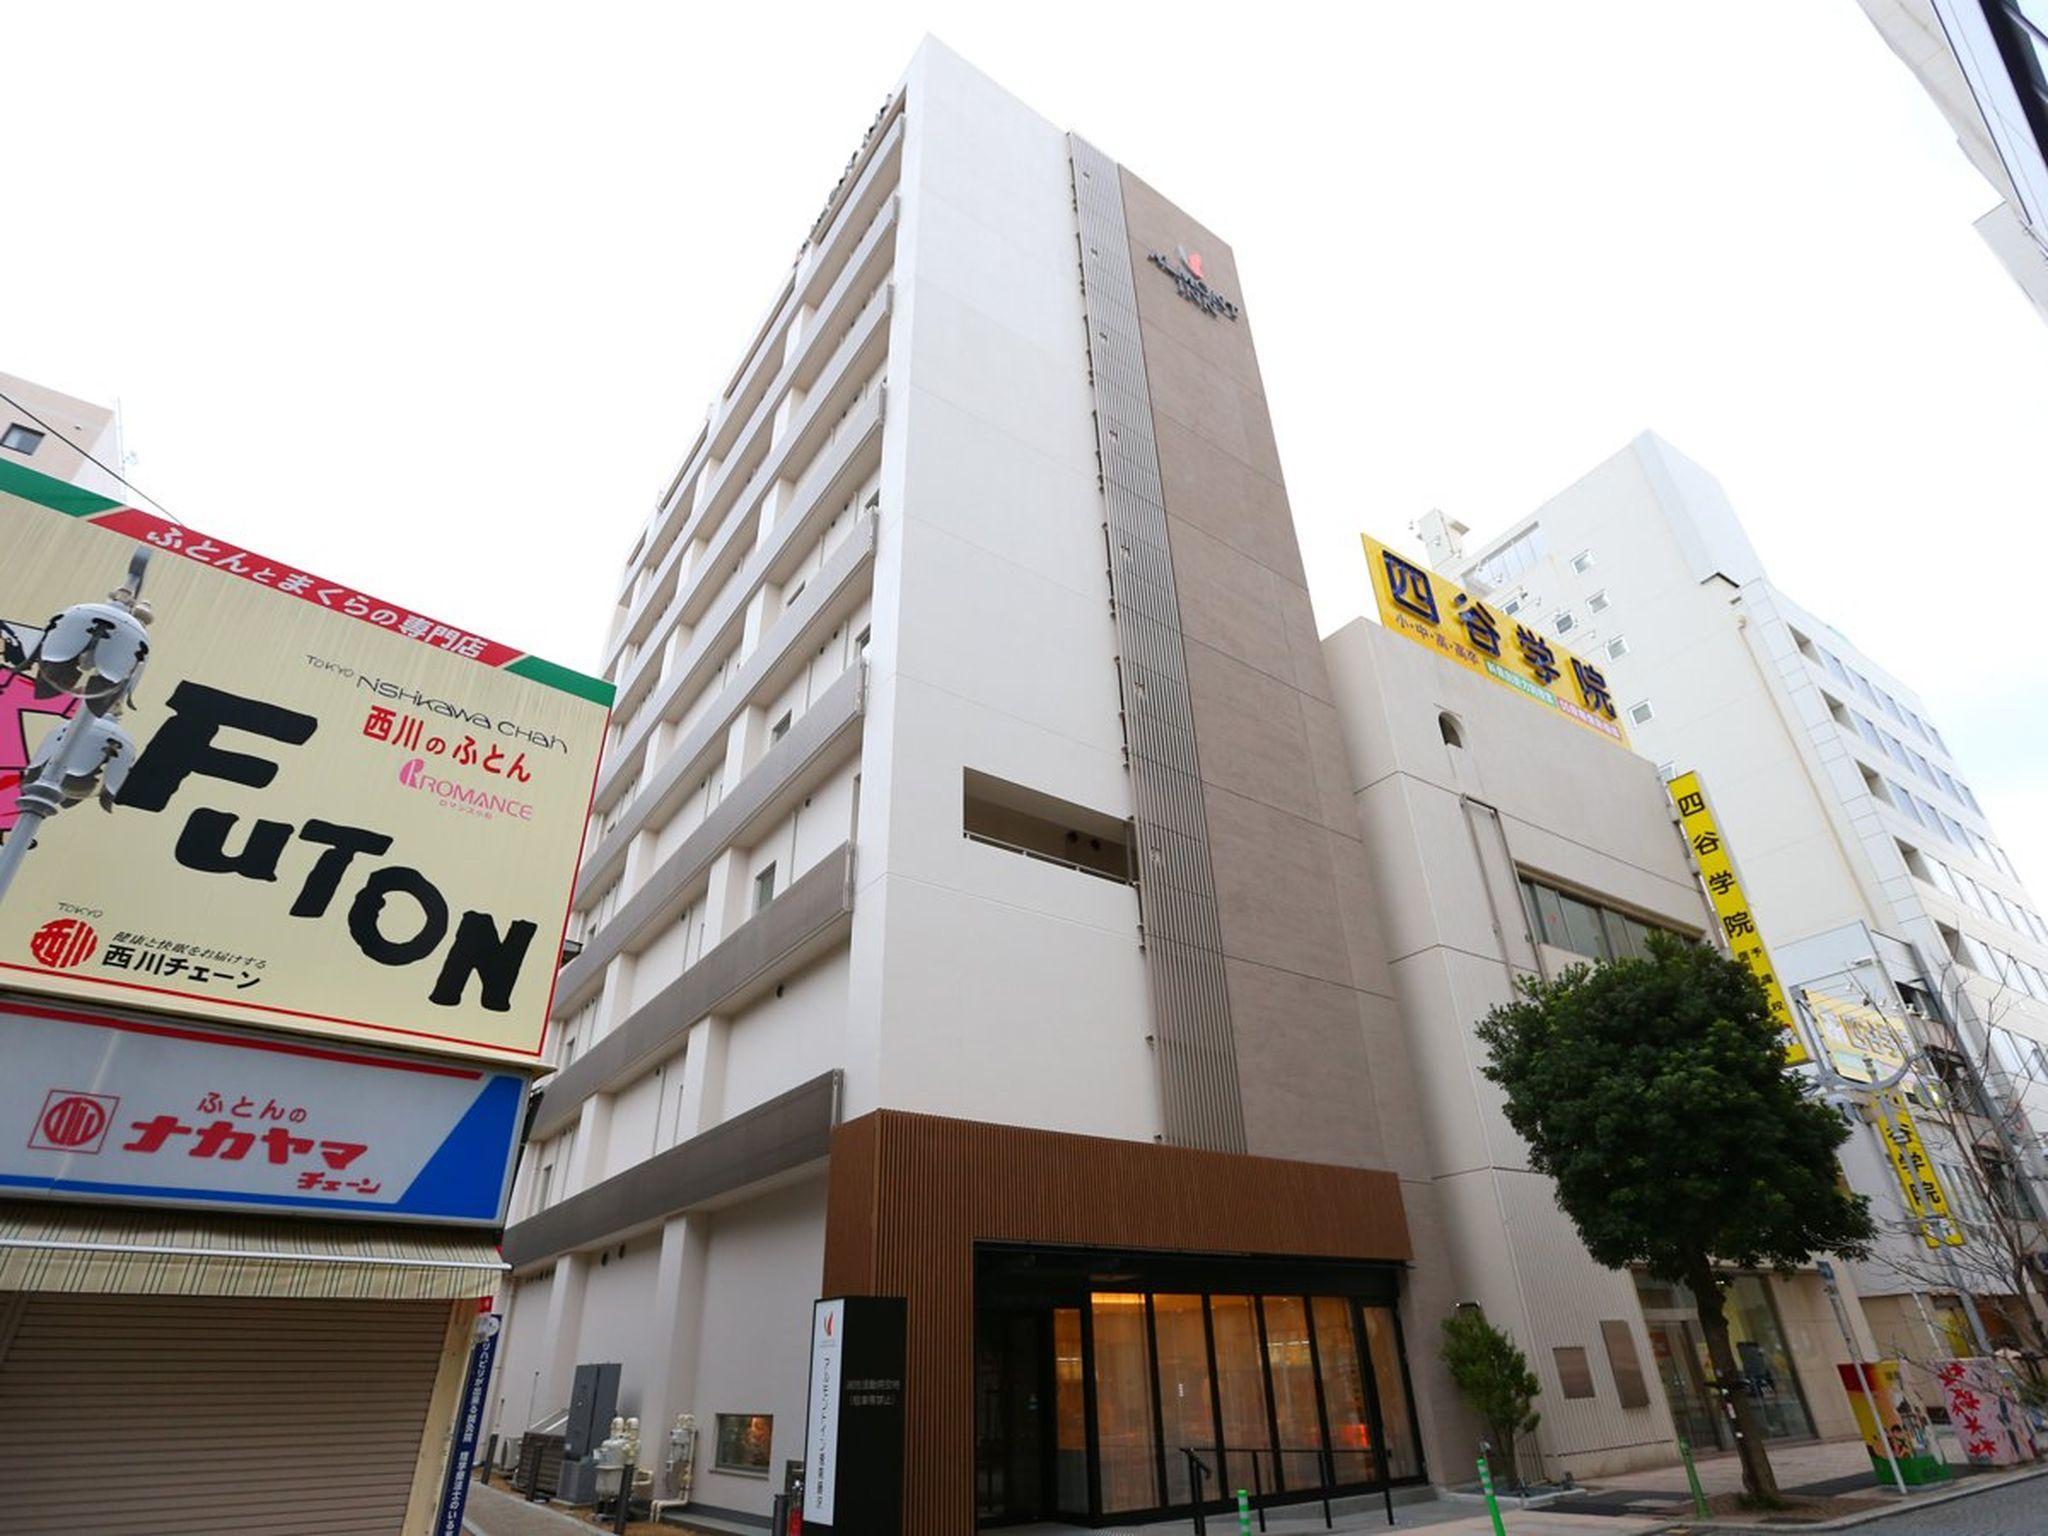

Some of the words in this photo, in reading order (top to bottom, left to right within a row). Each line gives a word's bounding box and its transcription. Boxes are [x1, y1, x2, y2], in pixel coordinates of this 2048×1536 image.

[147, 527, 488, 658] ふとんとまくらの専門店
[1382, 549, 1617, 720] 四谷学院
[307, 654, 354, 677] TOKYO
[363, 705, 531, 782] 西川のふとん
[419, 775, 533, 820] ROMANCE
[1678, 791, 1755, 938] 四谷学院
[58, 902, 103, 918] TOKYO
[102, 944, 260, 989] 西川チェーン
[197, 1092, 307, 1123] ふとんの
[123, 1115, 368, 1170] ナカヤマ
[297, 1172, 381, 1194] チェーン
